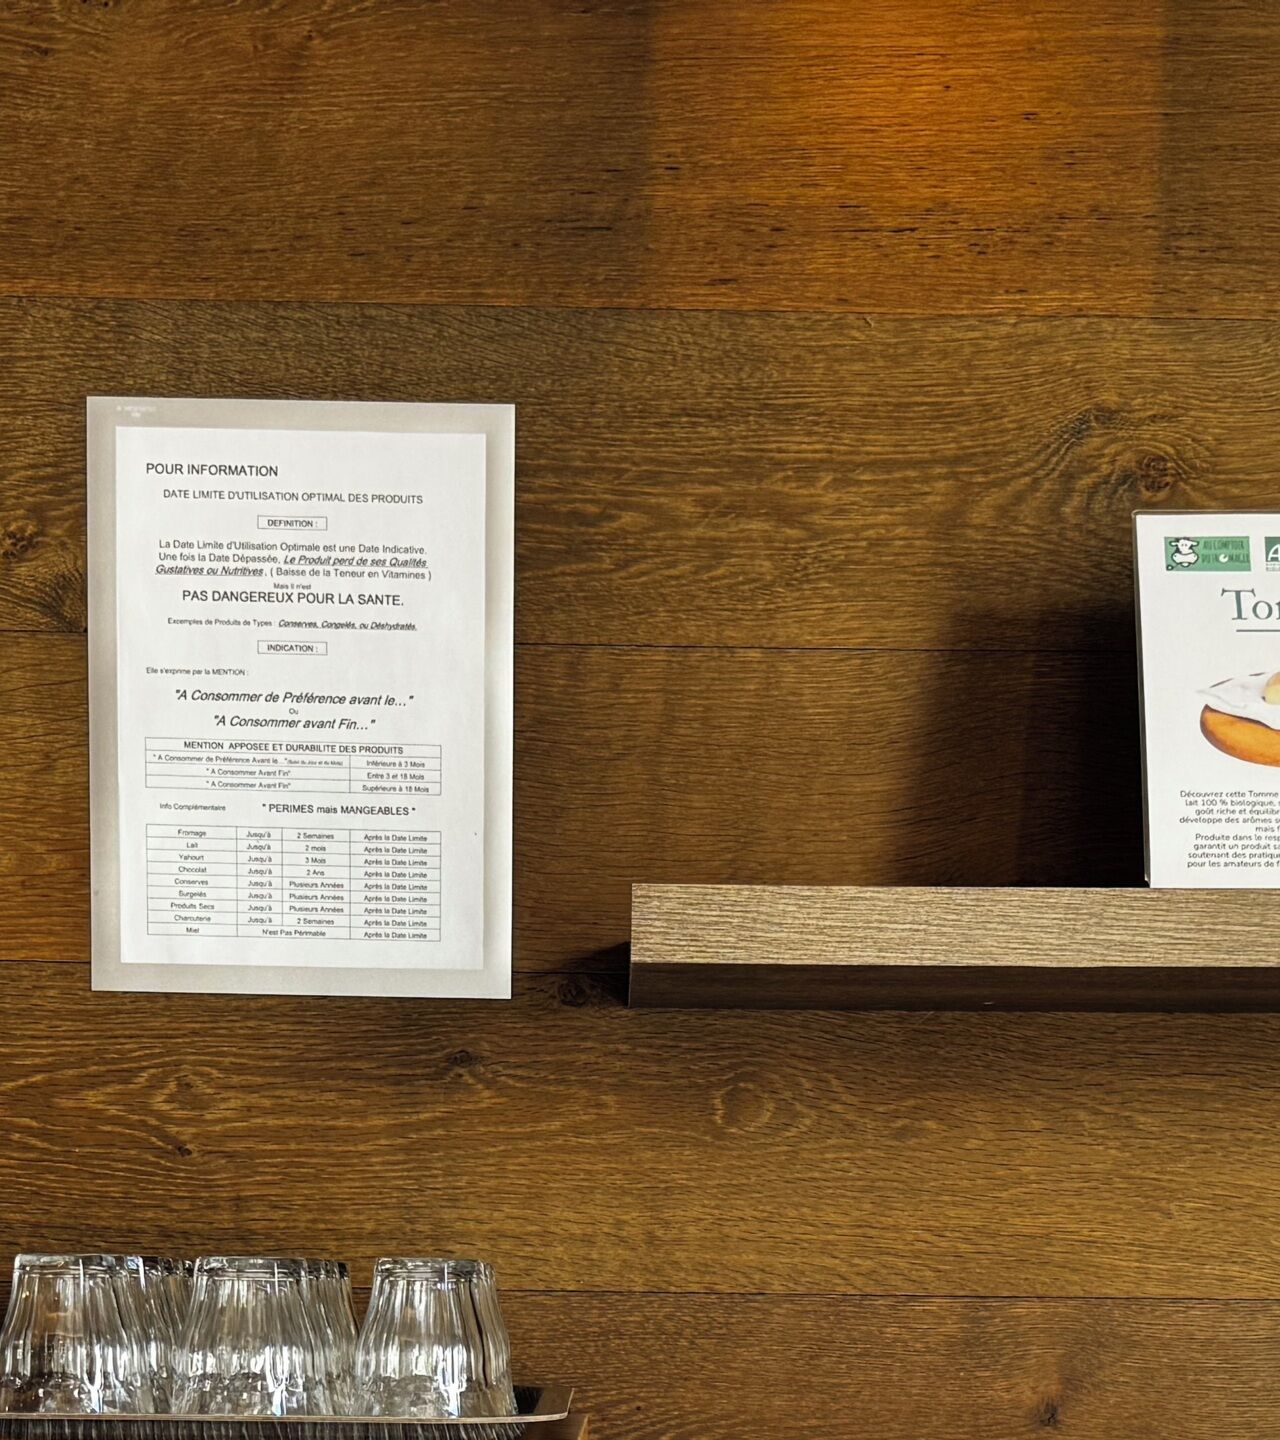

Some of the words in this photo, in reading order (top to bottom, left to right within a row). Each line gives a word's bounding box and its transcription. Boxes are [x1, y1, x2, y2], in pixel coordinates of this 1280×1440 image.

[146, 462, 184, 475] POUR
[187, 464, 278, 476] INFORMATION
[163, 489, 189, 498] DATE
[192, 490, 225, 499] LIMITE
[301, 492, 345, 502] OPTIMAL
[348, 493, 368, 503] DES
[371, 494, 423, 504] PRODUITS
[267, 519, 313, 527] DEFINITION
[159, 539, 170, 548] La
[173, 539, 194, 549] Date
[197, 540, 224, 549] Limite
[226, 541, 277, 550] d'Utilisation
[280, 542, 320, 553] Optimale
[322, 544, 336, 552] est
[358, 543, 379, 553] Date
[182, 590, 208, 601] PAS
[212, 590, 293, 603] DANGEREUX
[297, 592, 334, 604] POUR
[338, 593, 354, 604] LA
[358, 594, 403, 606] SANTE.
[267, 644, 313, 652] INDICATION
[191, 690, 262, 702] Consommer
[264, 692, 279, 702] de
[283, 692, 346, 704] Préférence
[349, 695, 382, 705] avant
[230, 716, 301, 728] Consommer
[303, 718, 336, 729] avant
[184, 741, 224, 749] MENTION
[229, 742, 269, 751] APPOSEE
[272, 743, 283, 751] ET
[286, 743, 336, 753] DURABILITE
[339, 745, 356, 753] DES
[359, 745, 403, 754] PRODUITS
[268, 803, 314, 813] PERIMES
[316, 805, 337, 814] mais
[340, 805, 409, 816] MANGEABLES
[1195, 833, 1230, 841] Produite
